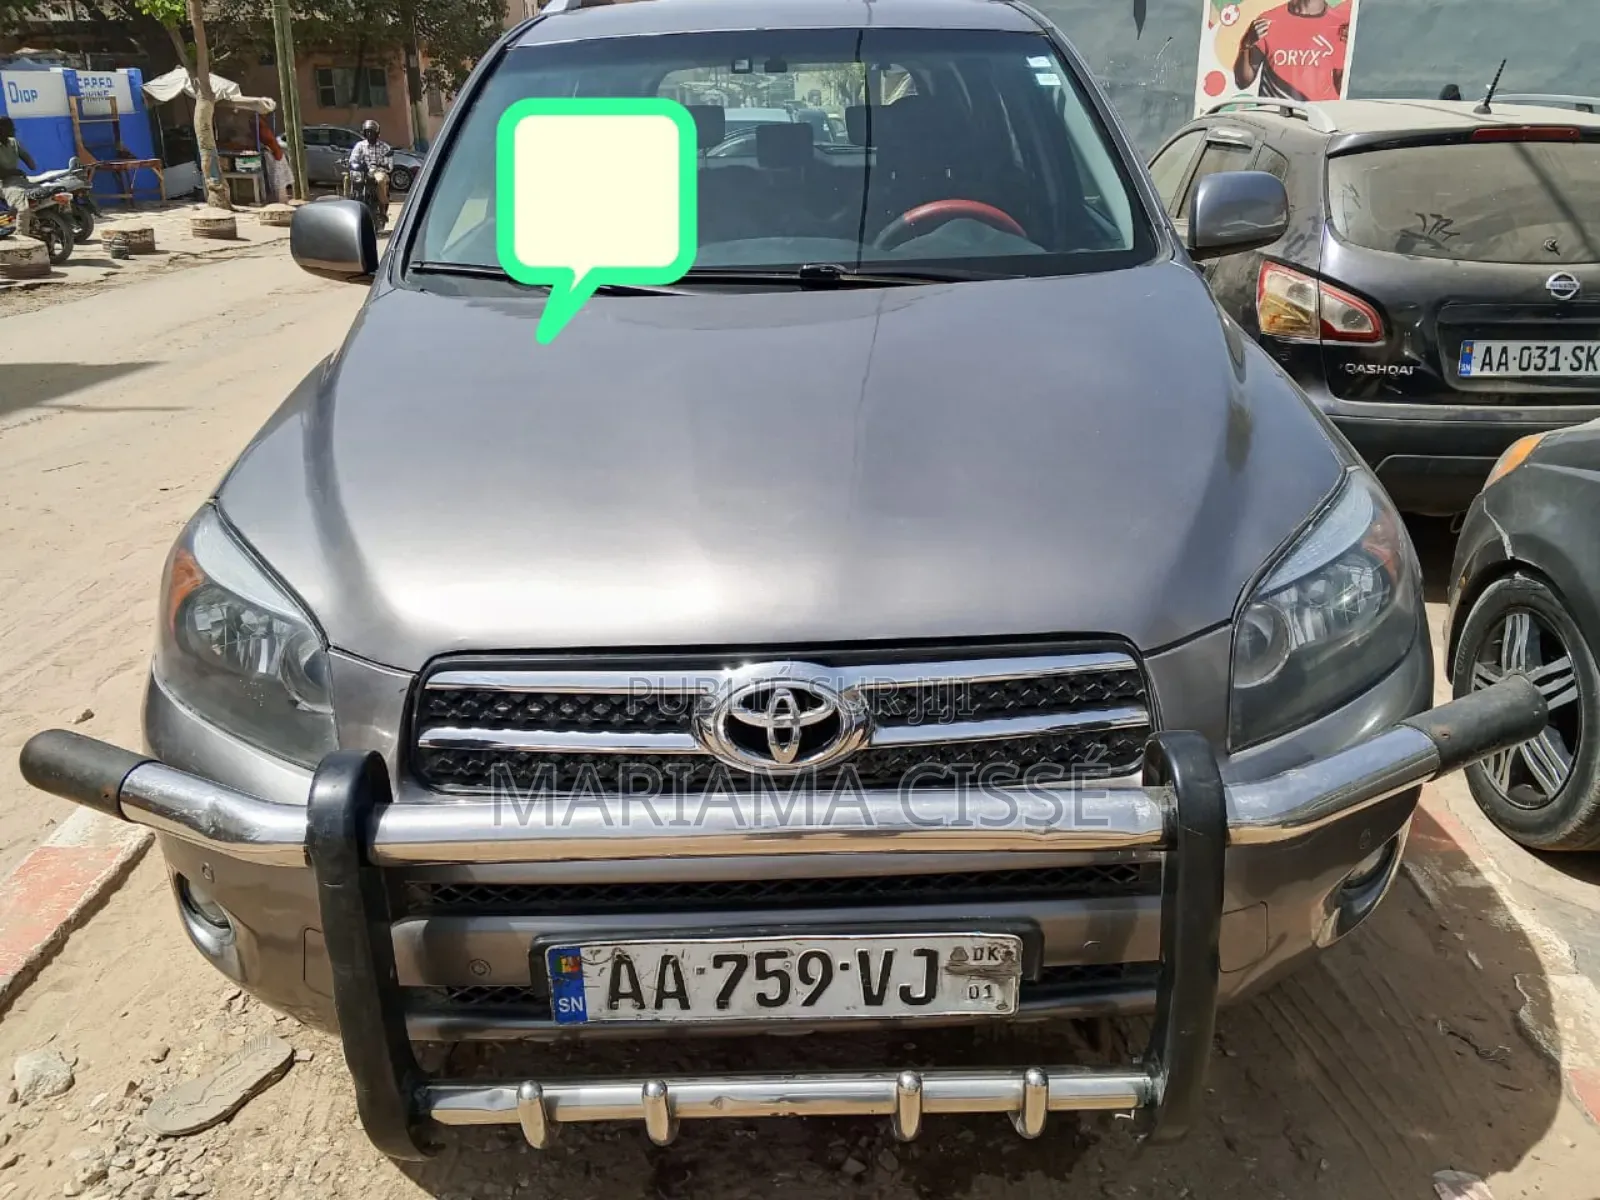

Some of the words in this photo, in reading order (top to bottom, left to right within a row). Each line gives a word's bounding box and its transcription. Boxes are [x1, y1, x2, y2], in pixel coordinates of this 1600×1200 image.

[1273, 49, 1321, 66] ORYX
[1344, 363, 1414, 376] QASHQAI
[972, 946, 999, 961] DK
[968, 984, 993, 1000] 01
[558, 998, 584, 1013] SN
